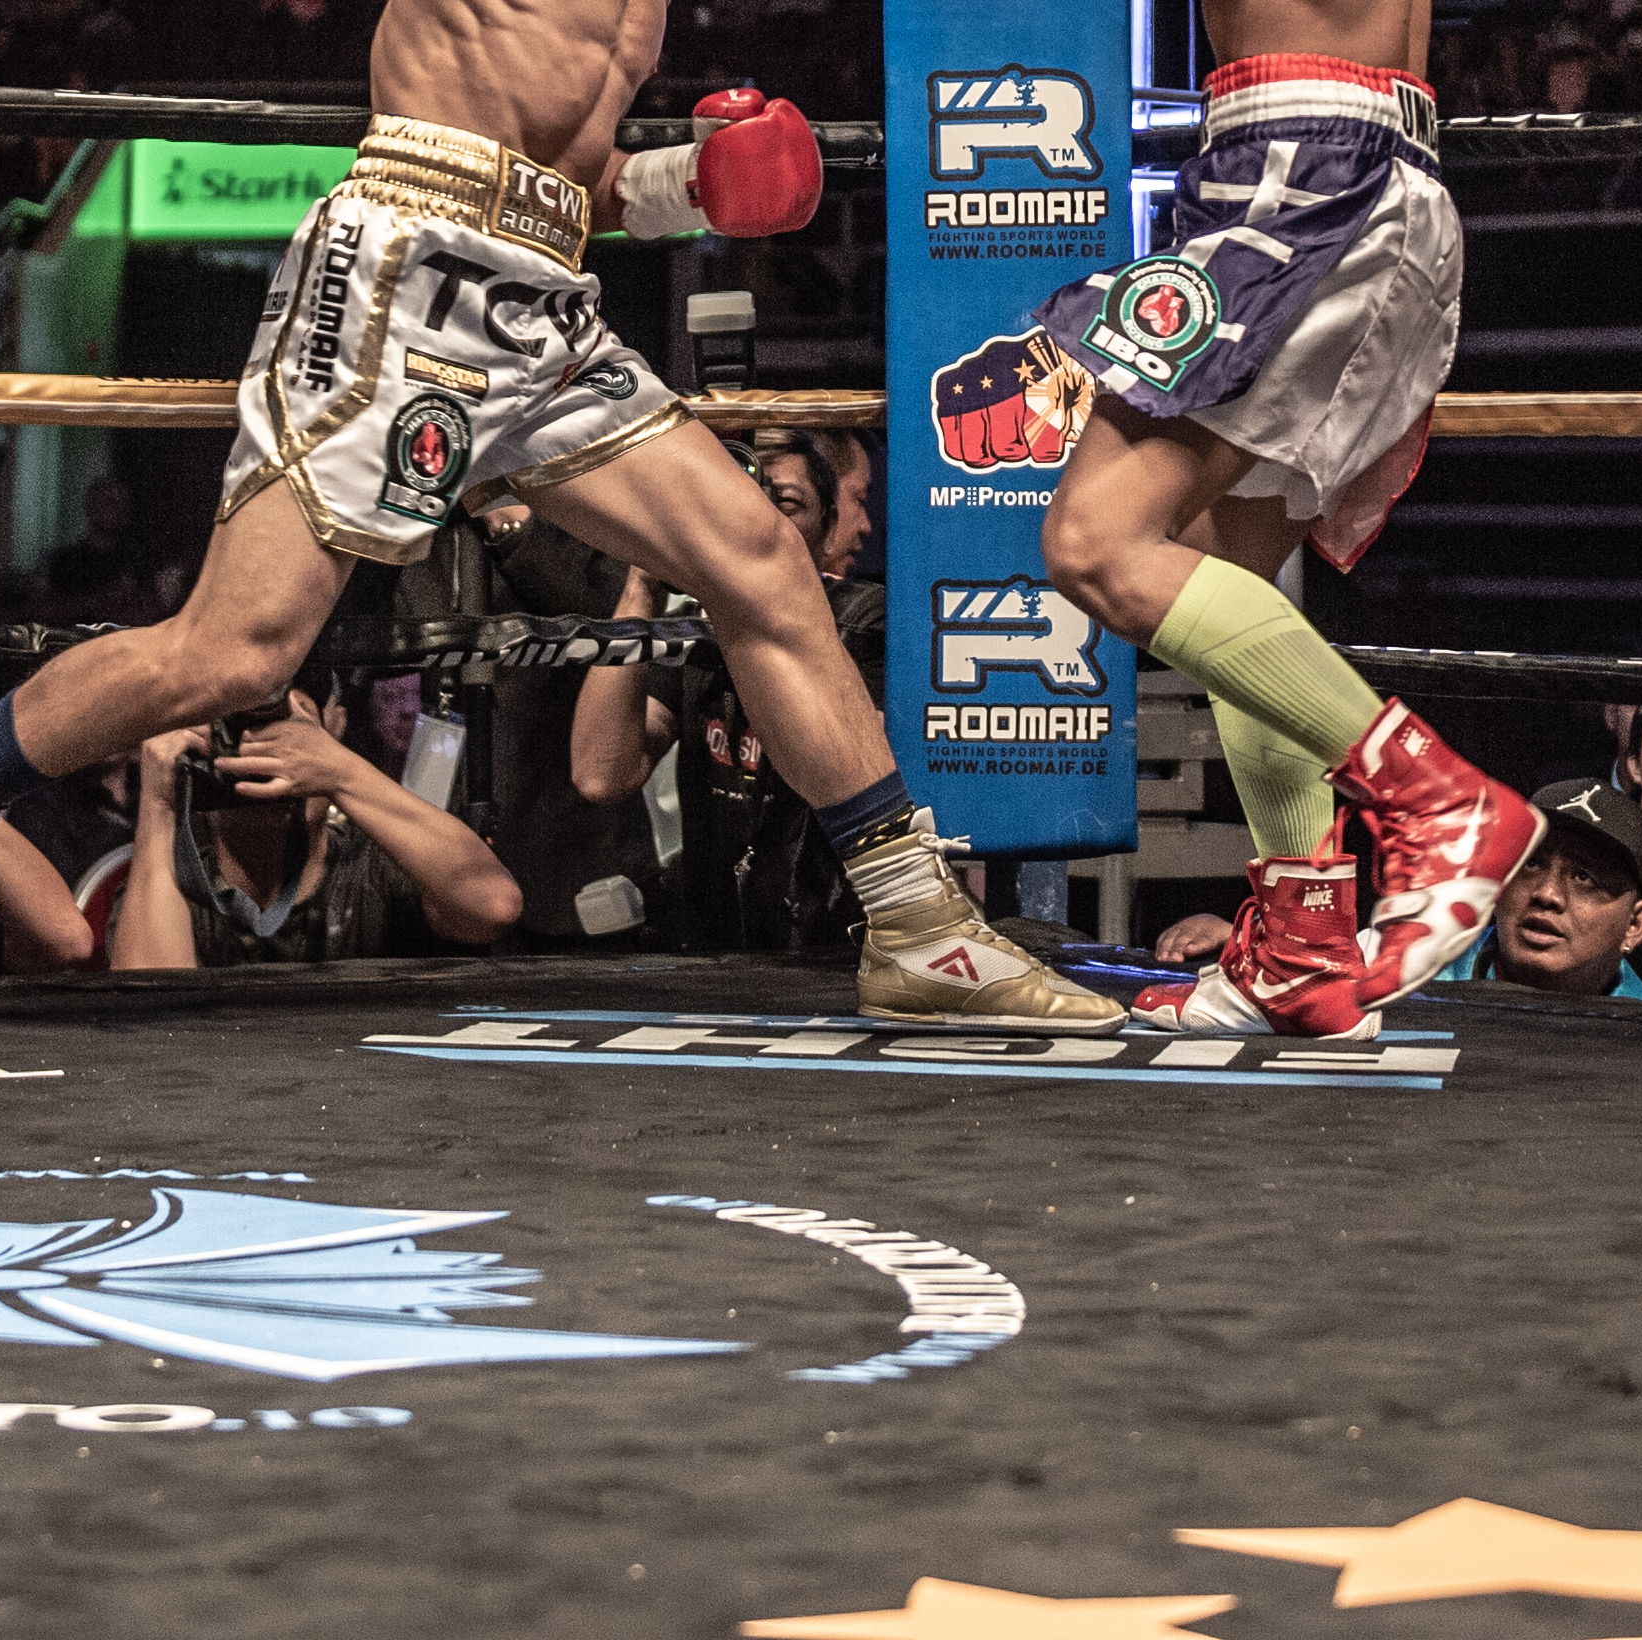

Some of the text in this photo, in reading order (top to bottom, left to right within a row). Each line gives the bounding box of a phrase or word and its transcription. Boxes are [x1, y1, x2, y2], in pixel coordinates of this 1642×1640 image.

[512, 162, 581, 222] TCW
[926, 190, 1107, 228] ROOMAIF
[501, 209, 575, 253] ROOMA
[928, 229, 1107, 243] FIGHTING SPORTS WORLD
[928, 243, 1107, 260] WWW.ROOMAIF.DE
[305, 221, 365, 393] ROOMAIF
[407, 352, 487, 387] RINGSTAR
[1091, 324, 1172, 380] IBO
[926, 705, 1110, 742] ROOMAIF
[927, 746, 1108, 758] FIGHTING SPORTS WORLD
[927, 759, 1108, 776] WWW.ROOMAIF.DE
[1302, 888, 1334, 907] NIKE
[362, 1021, 1460, 1073] FIGHT
